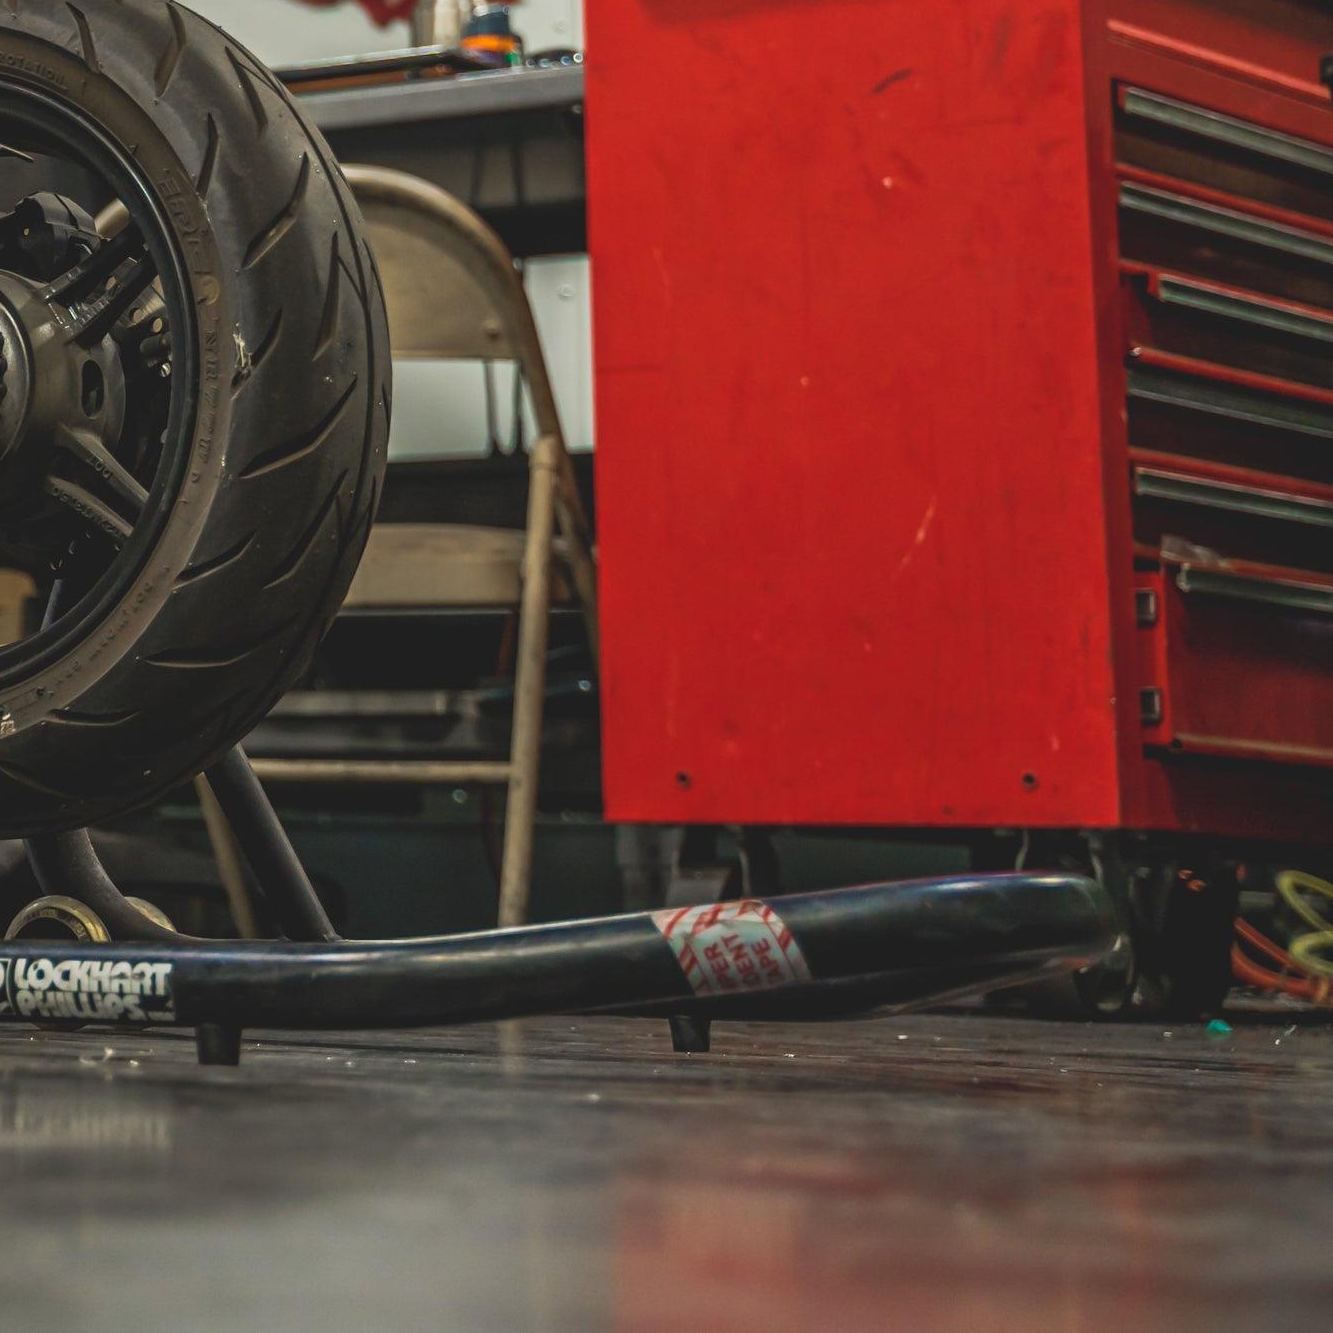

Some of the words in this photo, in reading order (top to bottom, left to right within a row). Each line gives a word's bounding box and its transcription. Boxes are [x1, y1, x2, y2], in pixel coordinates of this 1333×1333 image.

[14, 957, 173, 996] LOCKHART
[704, 942, 737, 989] PER
[722, 934, 761, 986] DENT
[15, 989, 148, 1021] PHILLIPS
